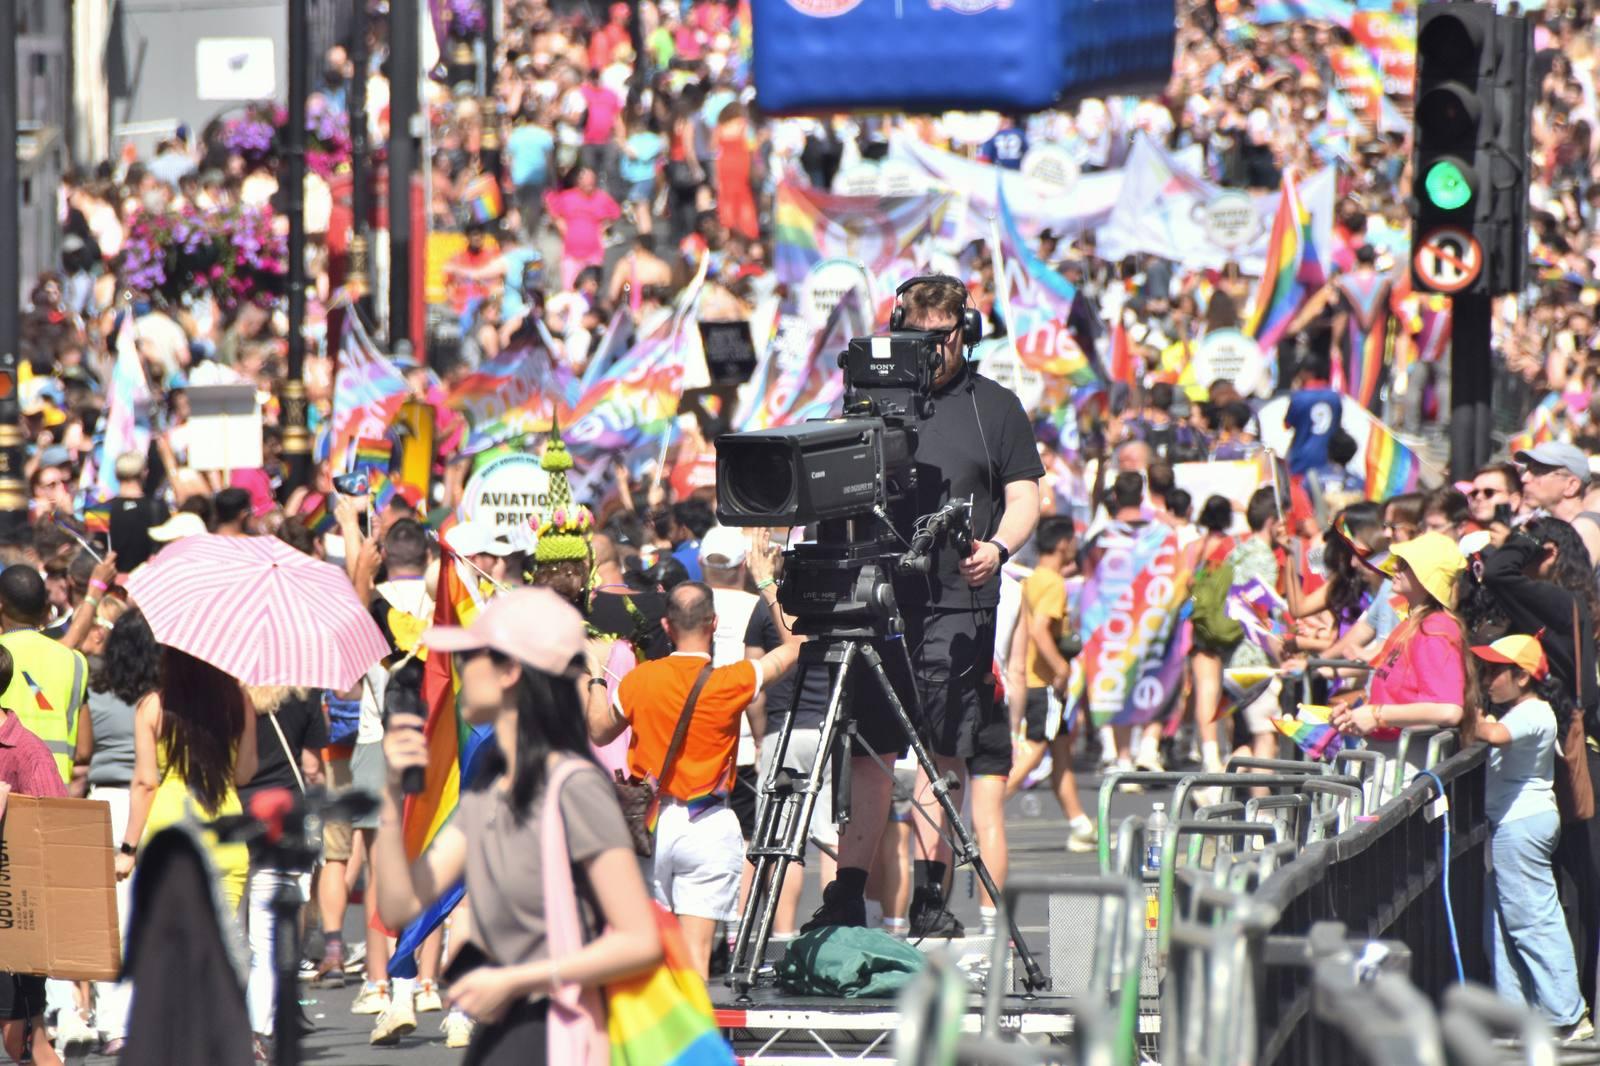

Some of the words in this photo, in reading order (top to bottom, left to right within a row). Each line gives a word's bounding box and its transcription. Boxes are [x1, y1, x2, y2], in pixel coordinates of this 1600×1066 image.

[1310, 402, 1333, 435] 9
[811, 471, 825, 479] Canon
[481, 492, 548, 506] AVIATIO
[496, 512, 543, 526] PRI
